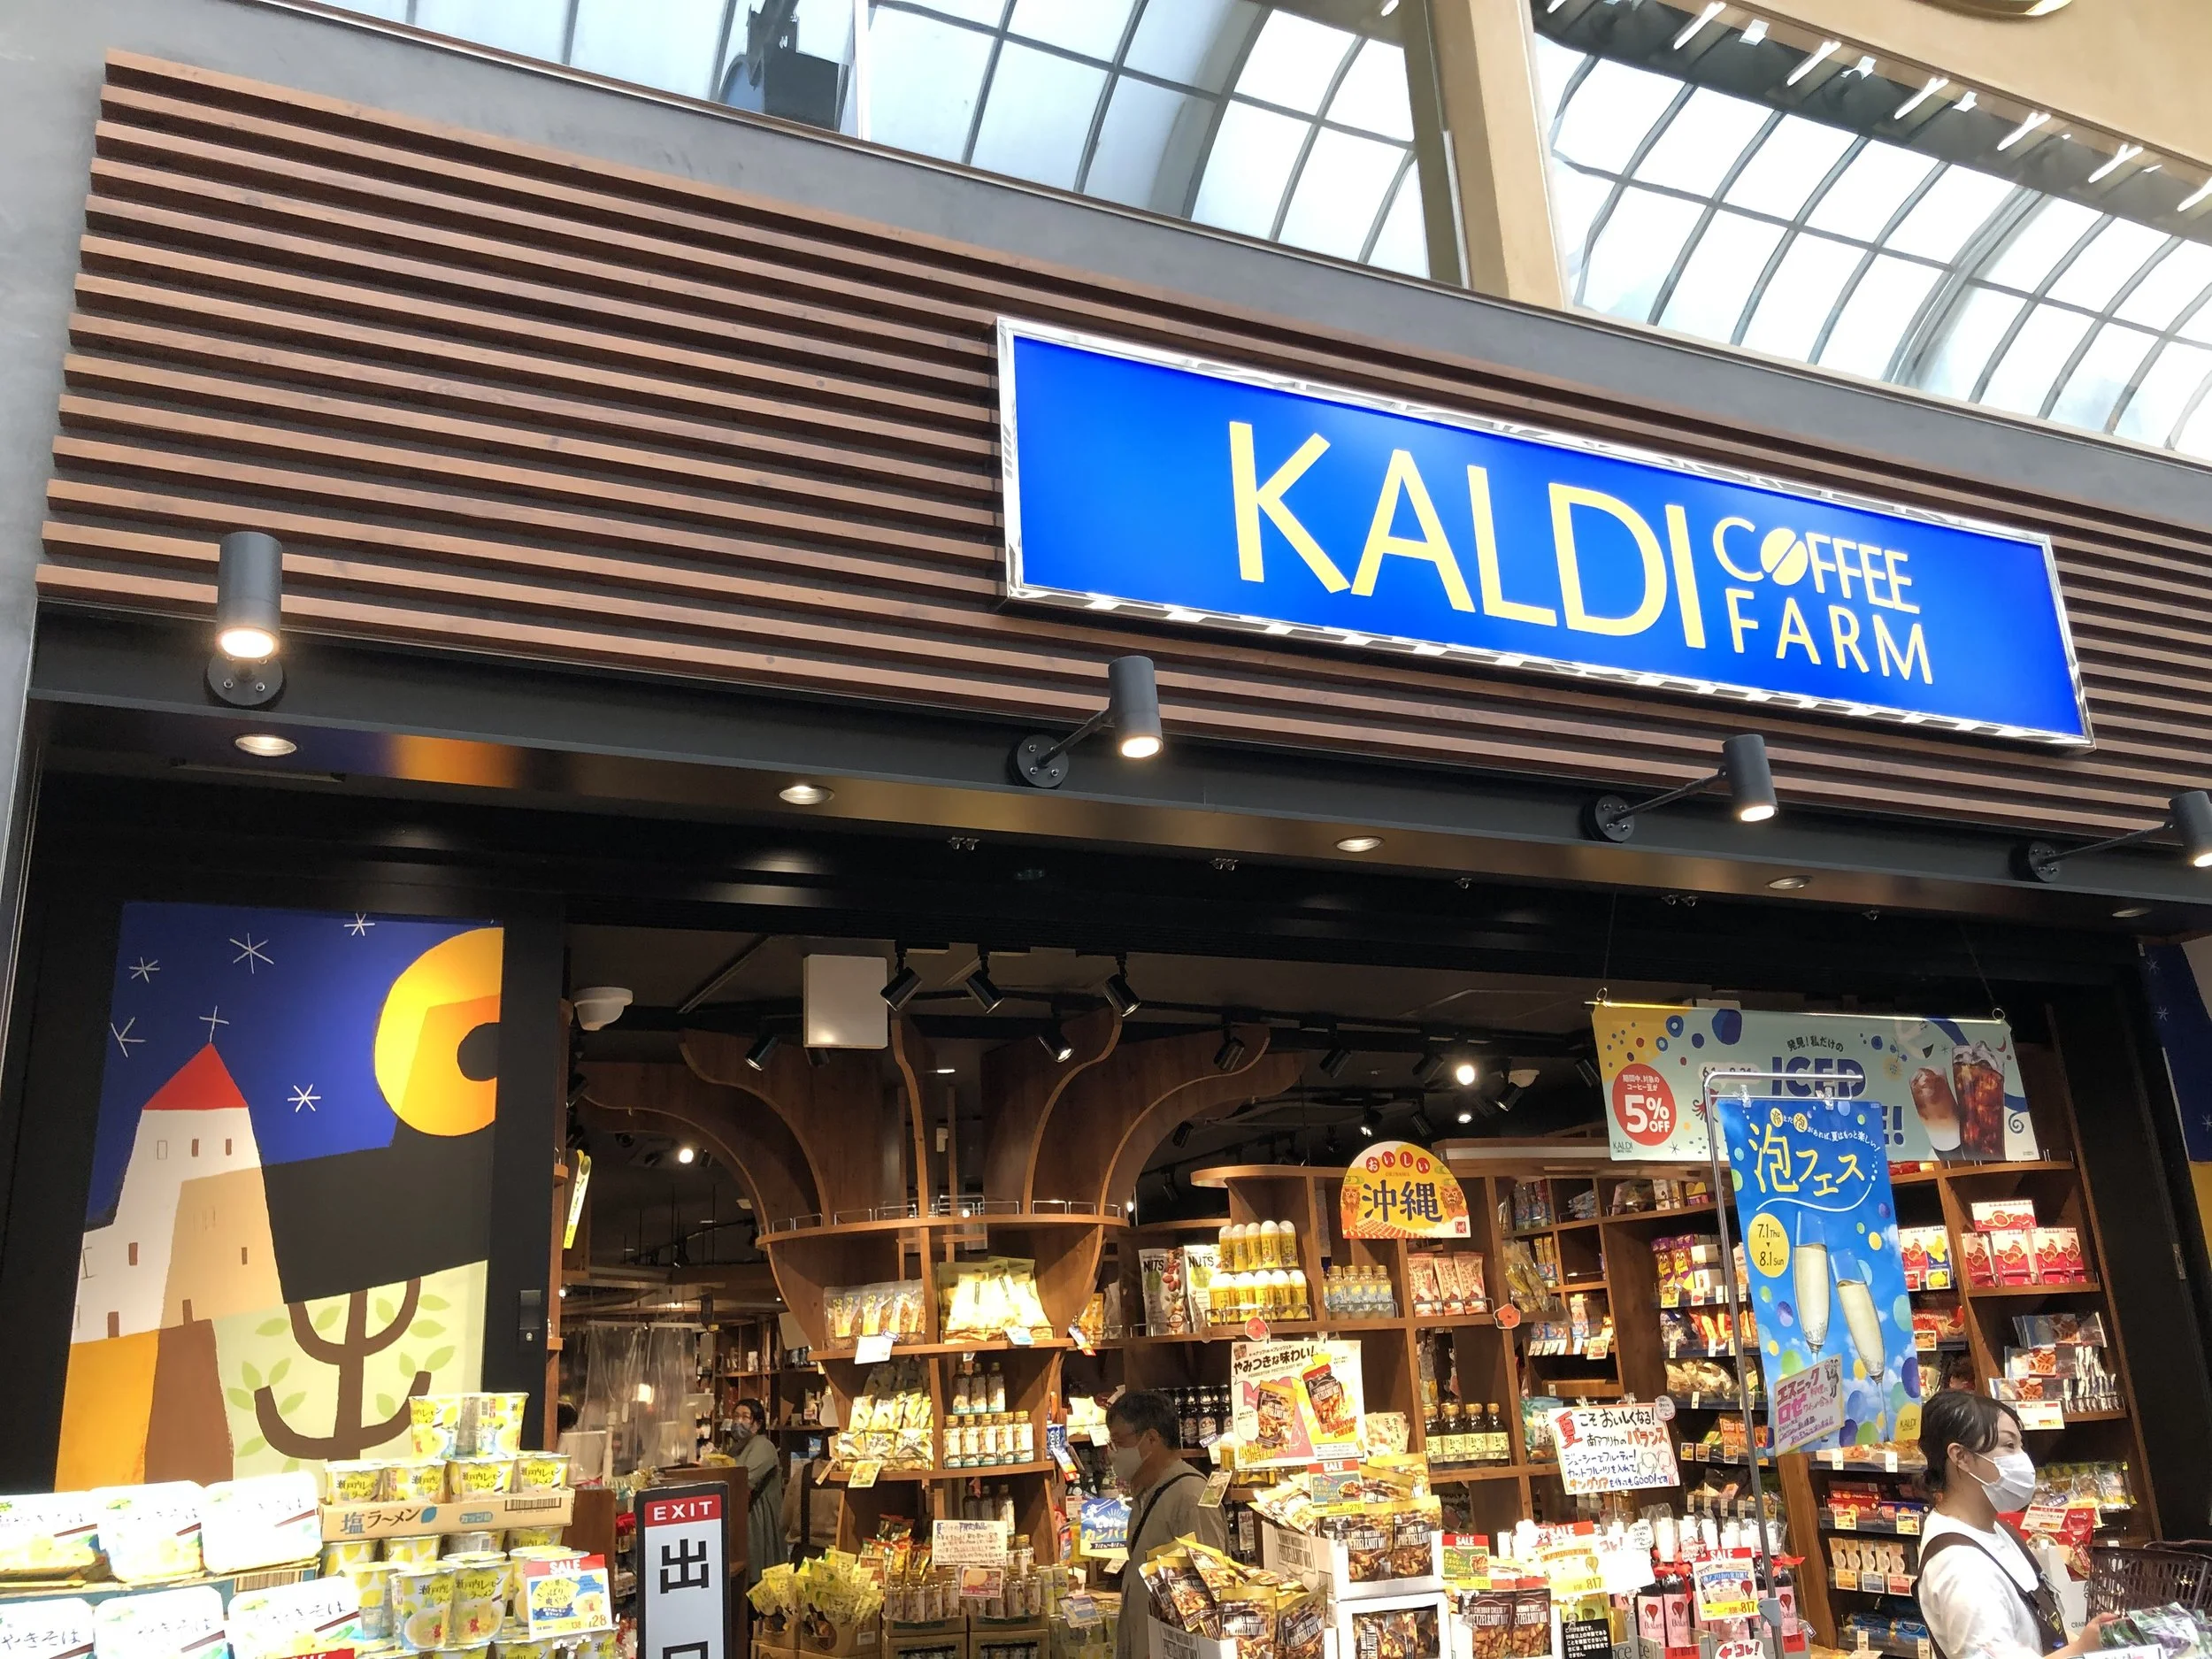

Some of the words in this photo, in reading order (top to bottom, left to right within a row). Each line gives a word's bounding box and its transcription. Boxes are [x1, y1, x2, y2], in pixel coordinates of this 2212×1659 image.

[1229, 420, 1709, 649] KALDI
[1712, 517, 1920, 615] COFFEE
[1724, 588, 1934, 686] FARM
[1771, 1056, 1867, 1097] ICED
[1624, 1094, 1670, 1133] 5%
[1648, 1120, 1671, 1133] OFF
[1367, 1153, 1429, 1171] おいしい
[1748, 1124, 1865, 1197] 泡フェス
[1362, 1179, 1443, 1222] 沖縄
[1757, 1223, 1769, 1238] 7.1
[1770, 1229, 1780, 1238] Thu
[1143, 1259, 1164, 1272] NUTS
[1188, 1256, 1214, 1268] NUTS
[1759, 1251, 1772, 1266] 8.1
[1773, 1257, 1784, 1266] Sun
[1233, 1345, 1314, 1375] やみつきな味わい!
[1777, 1367, 1819, 1407] エスニック
[1778, 1393, 1807, 1425] ロゼ
[1900, 1417, 1917, 1428] KALDI
[1323, 1461, 1344, 1472] SALE
[653, 1501, 713, 1521] EXIT
[1549, 1525, 1574, 1540] SALE
[1455, 1536, 1475, 1546] SALE
[1709, 1549, 1733, 1561] SALE
[549, 1559, 580, 1575] SALE
[1586, 1578, 1602, 1590] 817
[1740, 1601, 1755, 1613] 817
[1472, 1614, 1500, 1626] ETZEL&NUT
[1515, 1612, 1539, 1625] ETZEL&NUT
[1735, 1641, 1760, 1657] コレ!
